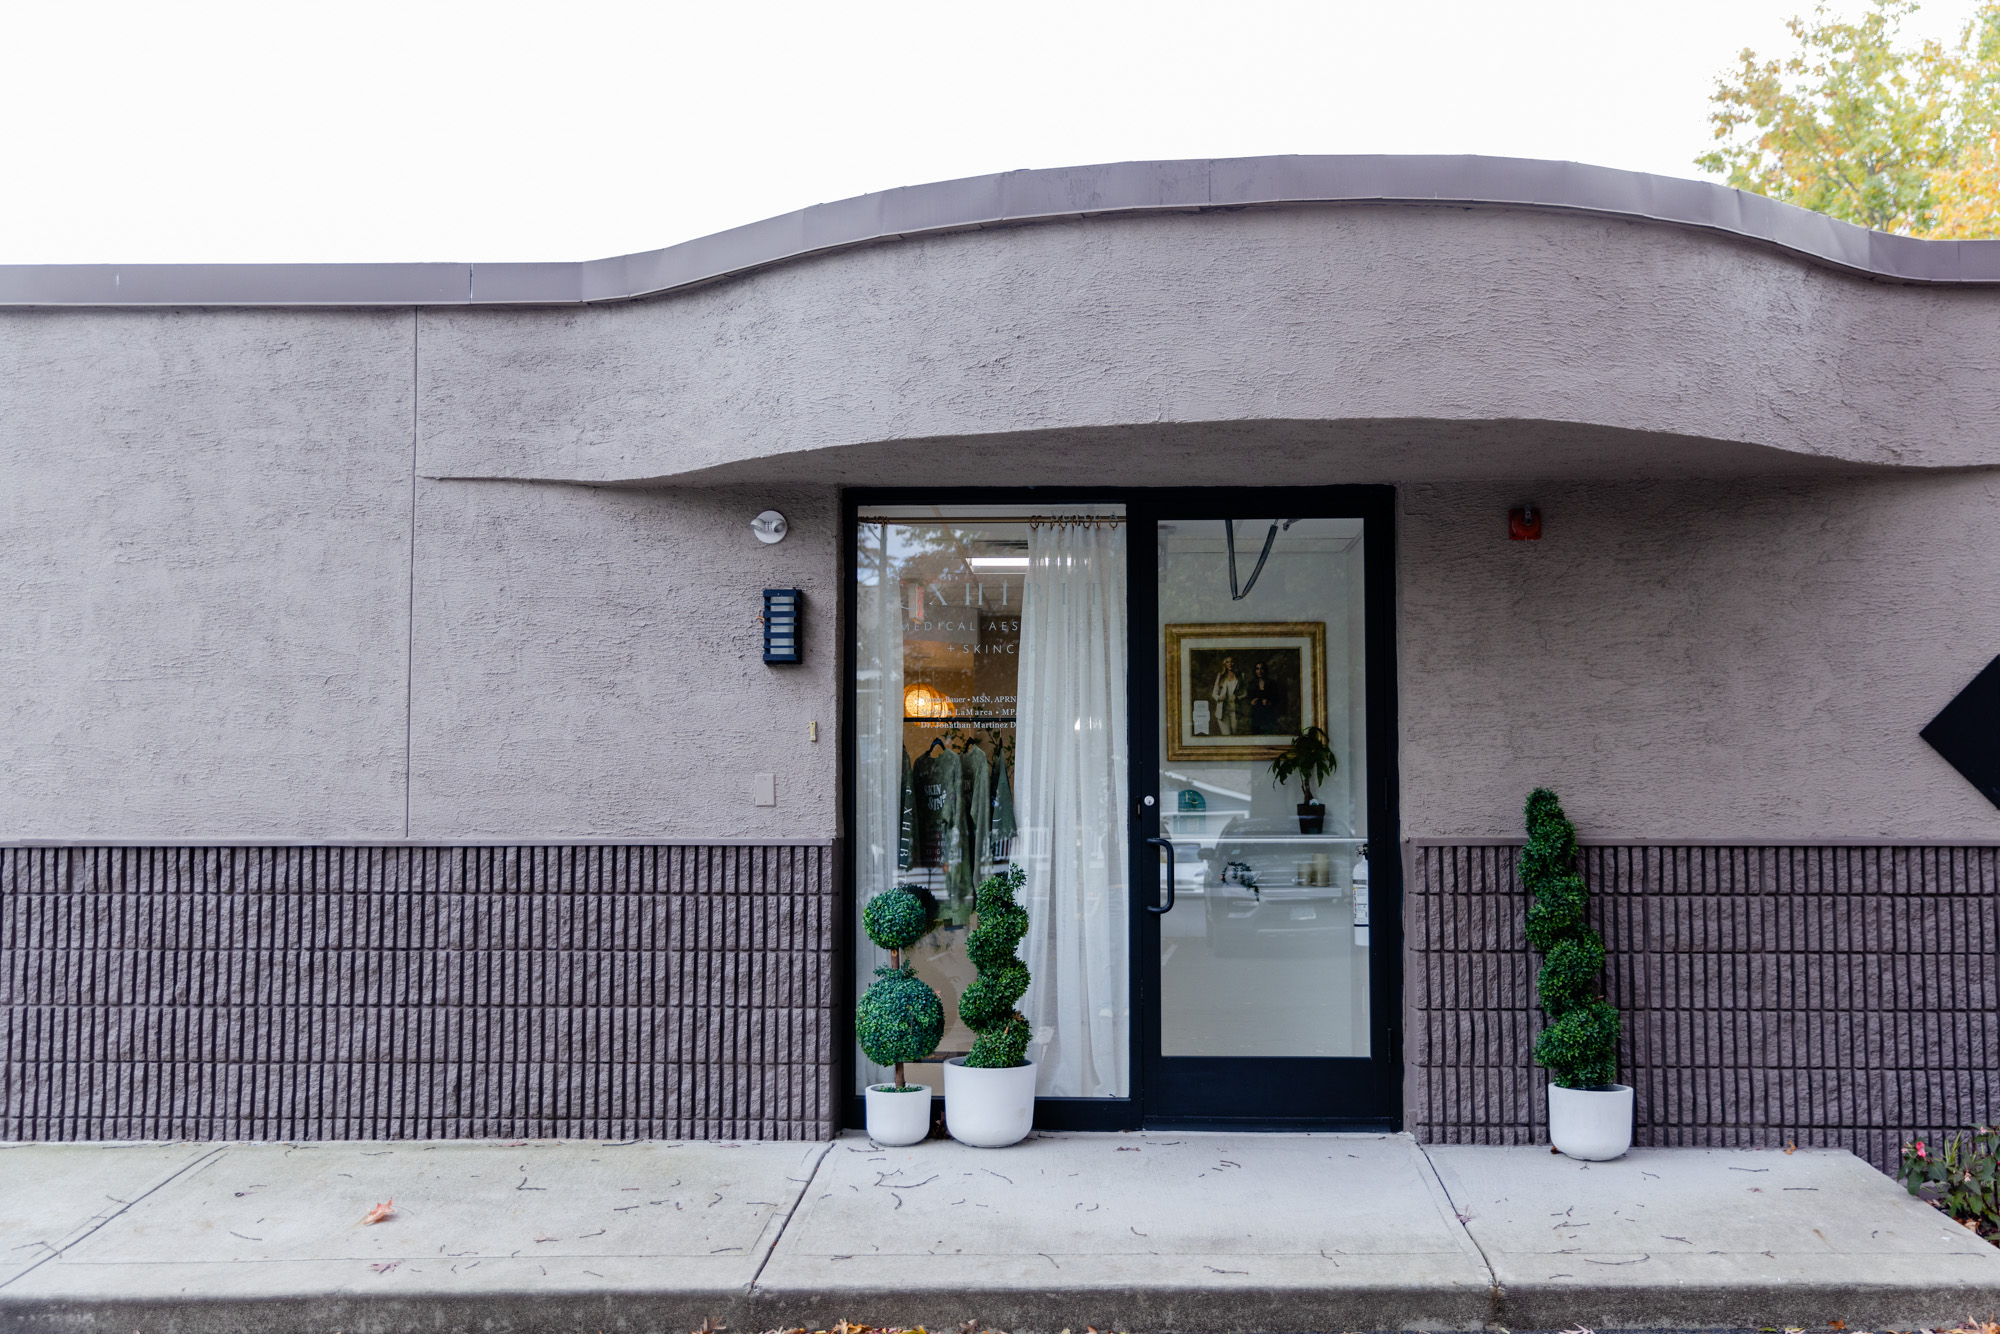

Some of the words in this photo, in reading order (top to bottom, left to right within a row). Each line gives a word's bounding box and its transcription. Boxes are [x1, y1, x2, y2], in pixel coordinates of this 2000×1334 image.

[901, 621, 976, 632] MEDICAL
[963, 644, 1015, 655] SKINC
[945, 696, 966, 704] Bauer
[972, 695, 993, 704] MSN,
[994, 695, 1017, 703] APRN
[954, 708, 993, 716] LaMarca
[1001, 708, 1017, 716] MP
[920, 721, 933, 729] Dr.
[934, 721, 971, 729] Jonathan
[973, 721, 1008, 729] Martinez
